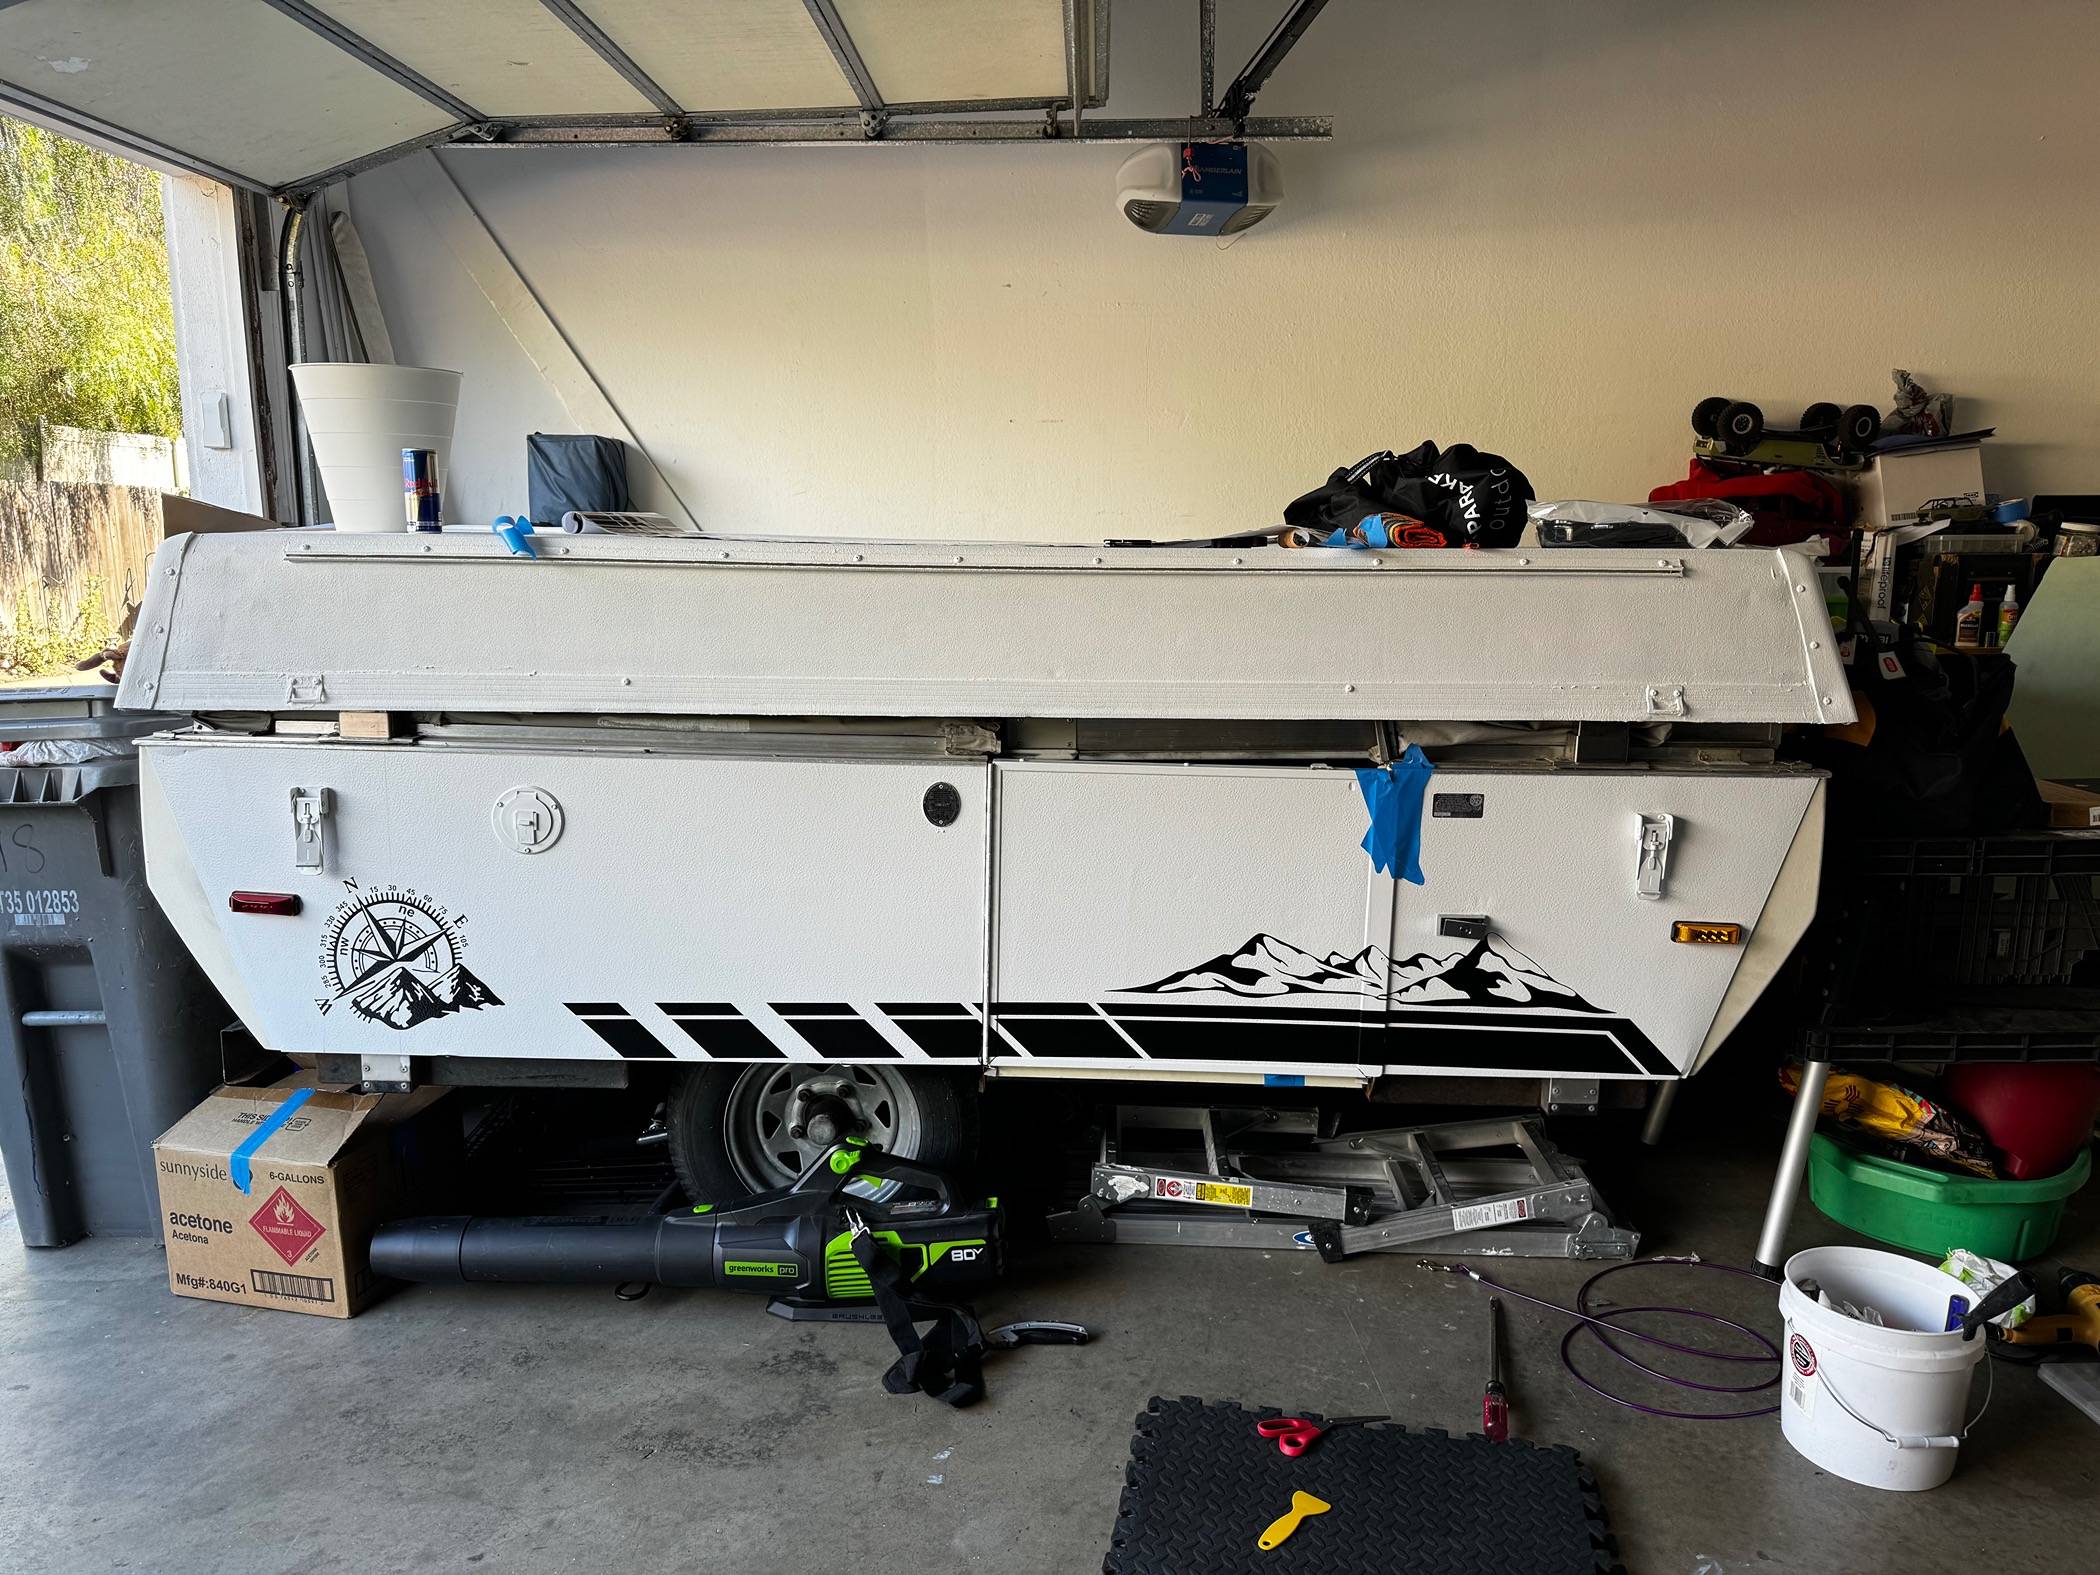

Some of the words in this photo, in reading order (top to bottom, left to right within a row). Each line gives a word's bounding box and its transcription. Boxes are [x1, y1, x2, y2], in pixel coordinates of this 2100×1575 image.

[343, 877, 358, 893] N
[406, 888, 416, 896] 45
[423, 894, 432, 903] 60
[26, 889, 80, 913] 012853
[335, 901, 349, 913] 345
[398, 905, 415, 917] ne
[438, 906, 448, 915] 75
[324, 915, 336, 928] 330
[453, 914, 469, 929] E
[320, 934, 328, 948] 315
[339, 937, 349, 955] nw
[459, 935, 469, 948] 105
[318, 955, 327, 968] 300
[320, 975, 332, 989] 285
[314, 998, 333, 1016] W
[160, 1160, 227, 1181] sunnyside
[269, 1171, 325, 1184] 6-GALLONS
[169, 1211, 233, 1234] acetone
[172, 1229, 209, 1244] Acetona
[263, 1226, 293, 1236] FLAMMABLE
[294, 1229, 312, 1238] LIQUID
[286, 1250, 293, 1258] 3
[728, 1264, 774, 1274] greenworks
[779, 1265, 796, 1276] pro
[176, 1272, 247, 1295] Mfg#:840G1
[832, 1312, 883, 1320] BRUSHLES
